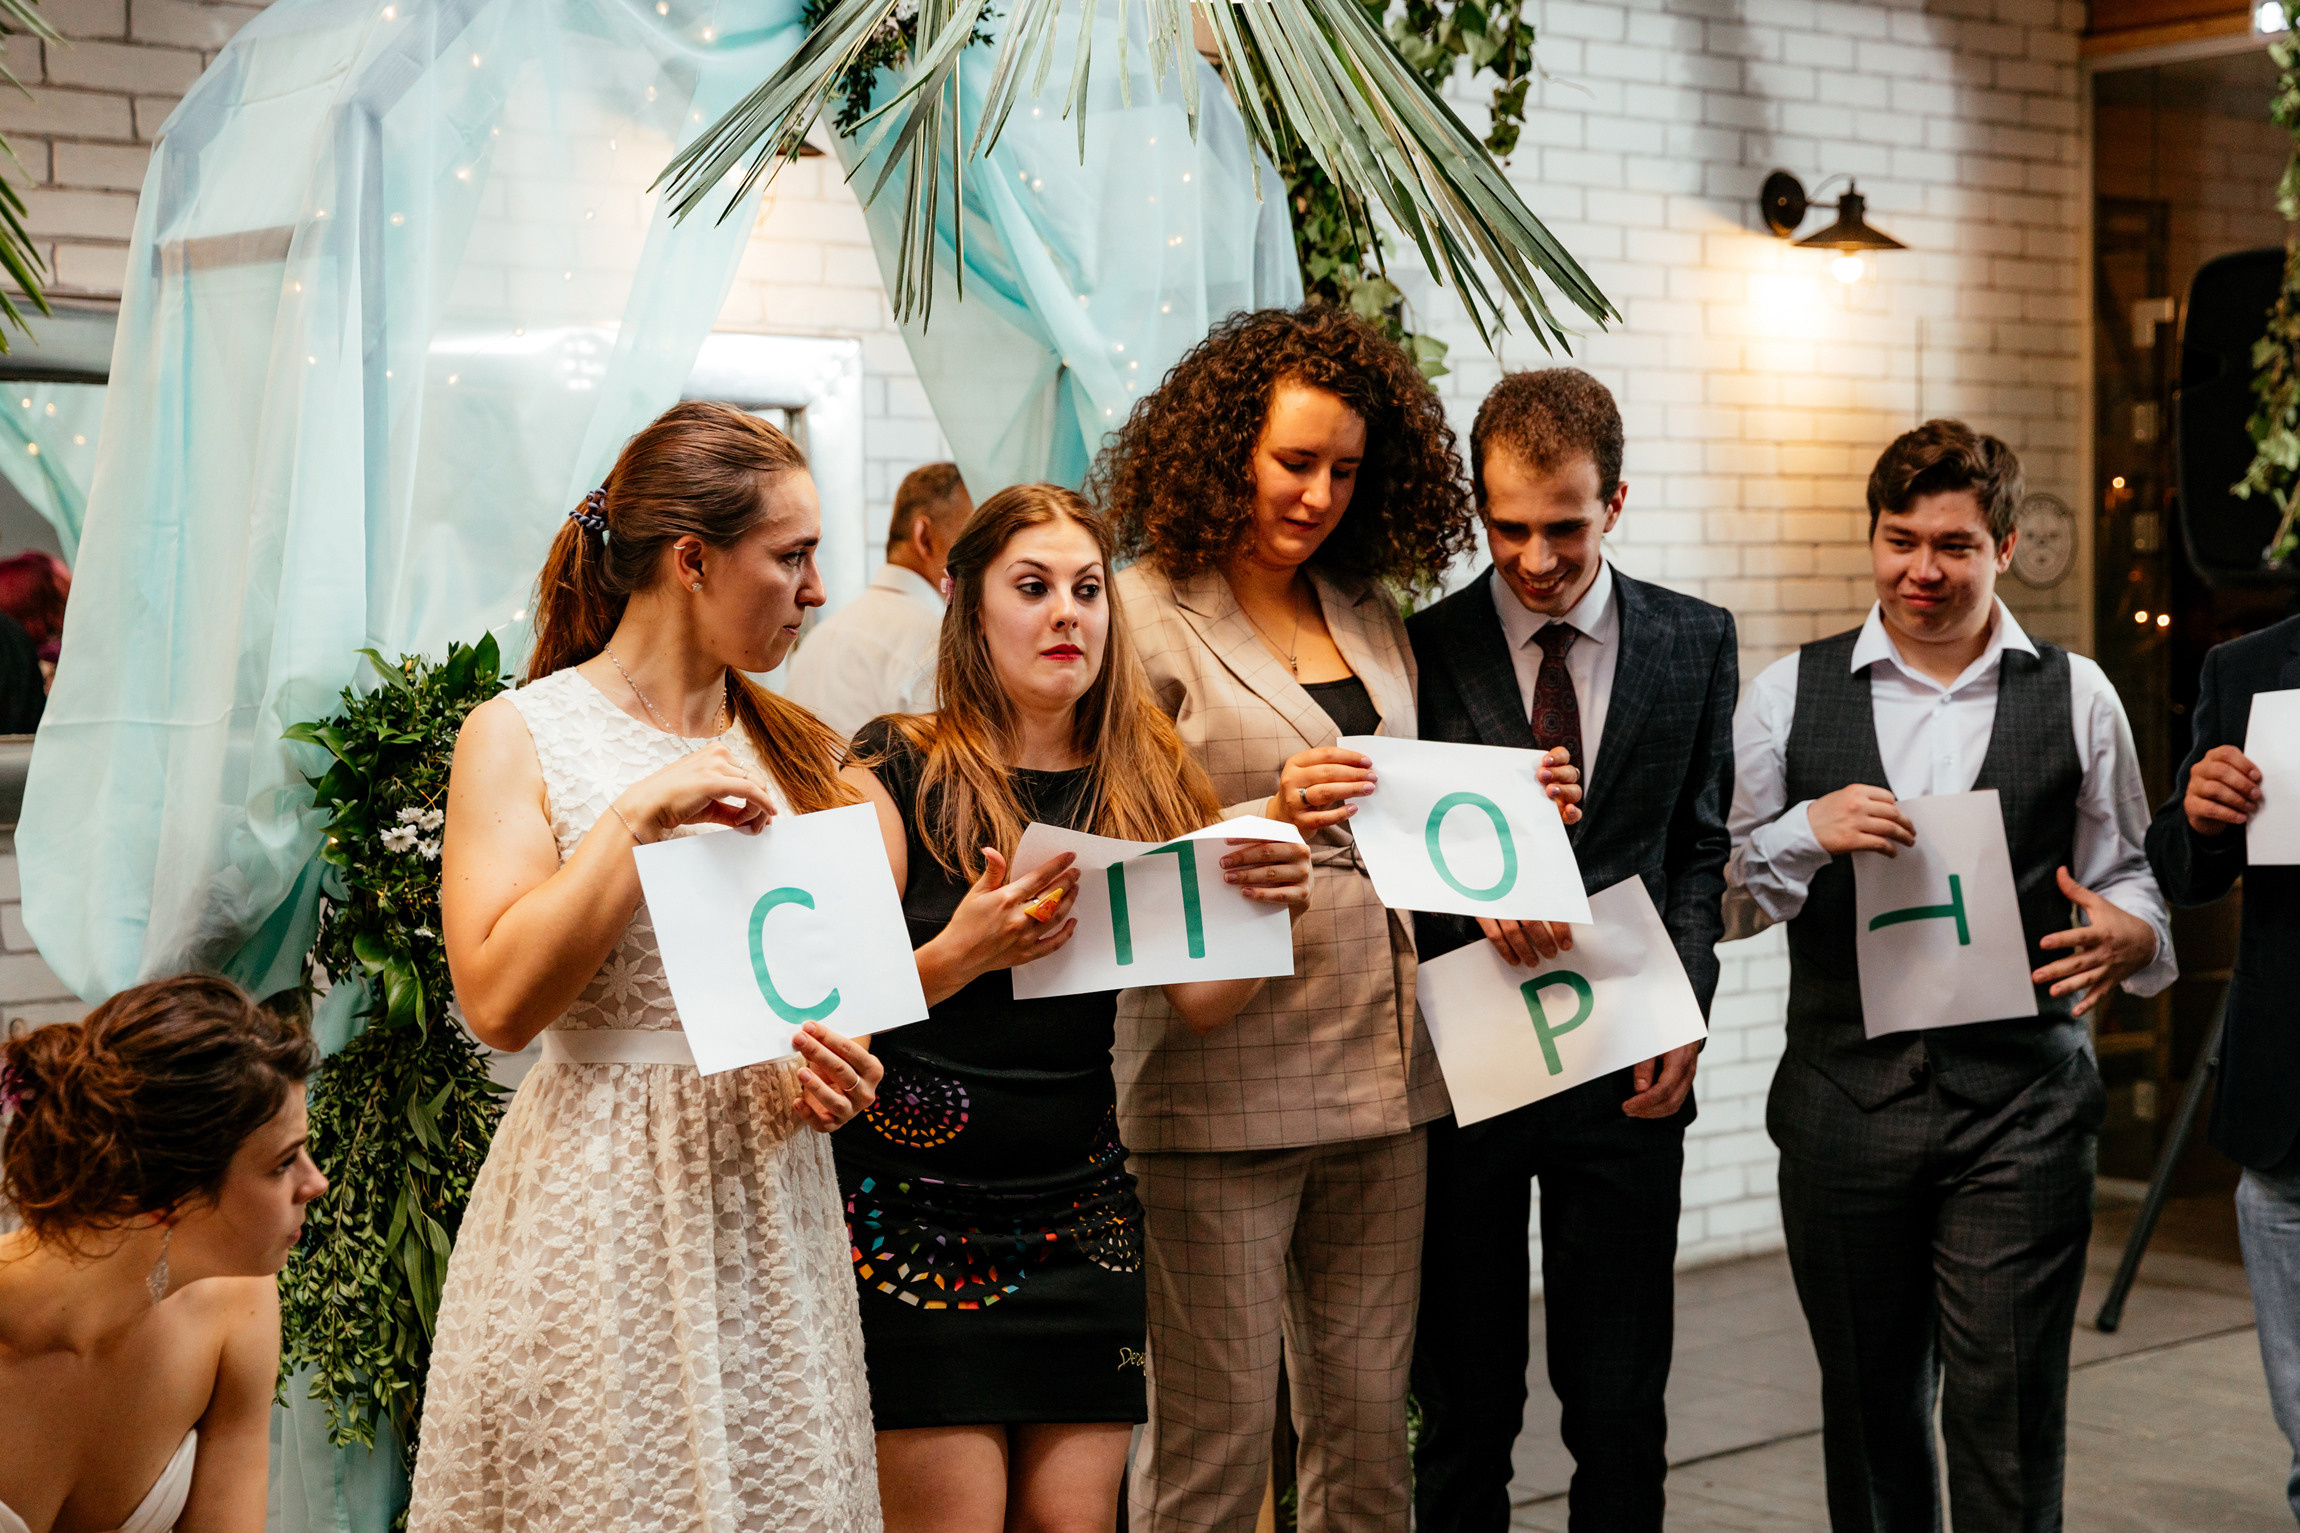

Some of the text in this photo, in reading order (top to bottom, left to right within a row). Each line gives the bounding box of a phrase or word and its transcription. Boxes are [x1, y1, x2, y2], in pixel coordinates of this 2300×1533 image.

[1425, 792, 1518, 901] О
[748, 886, 841, 1025] С
[1107, 840, 1206, 965] П
[1869, 874, 1971, 946] Т
[1520, 970, 1594, 1075] Р
